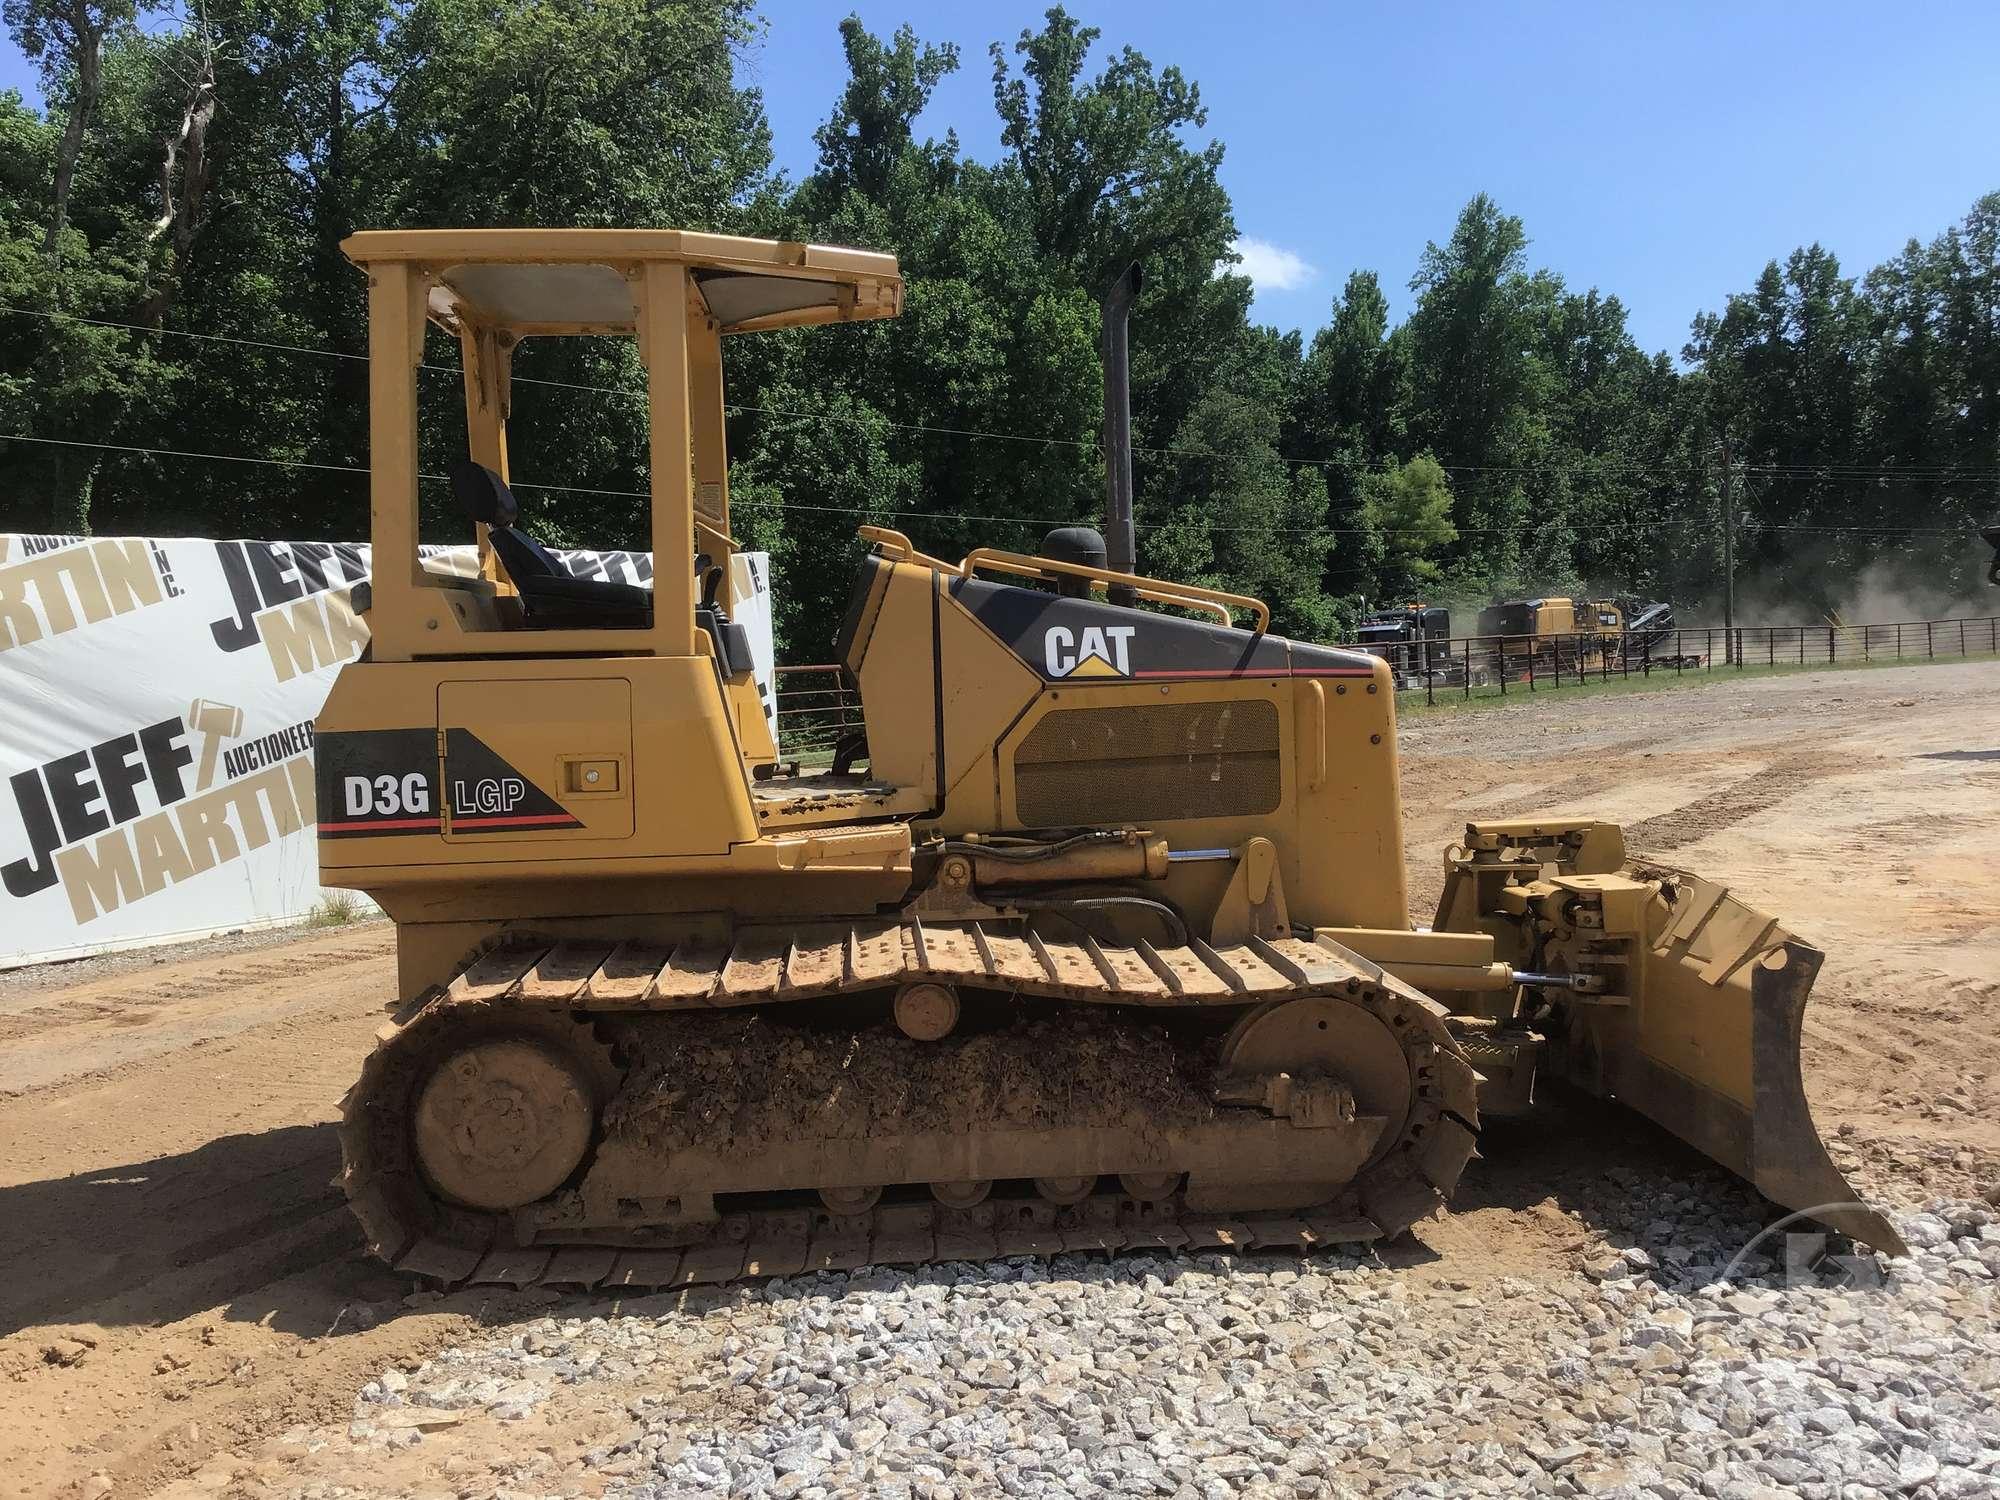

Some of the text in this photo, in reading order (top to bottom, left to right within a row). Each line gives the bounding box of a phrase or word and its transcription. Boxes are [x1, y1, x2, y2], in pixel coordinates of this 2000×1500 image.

[1045, 626, 1136, 678] CAT
[0, 716, 193, 897] JEFF
[345, 773, 526, 816] D3G LGP
